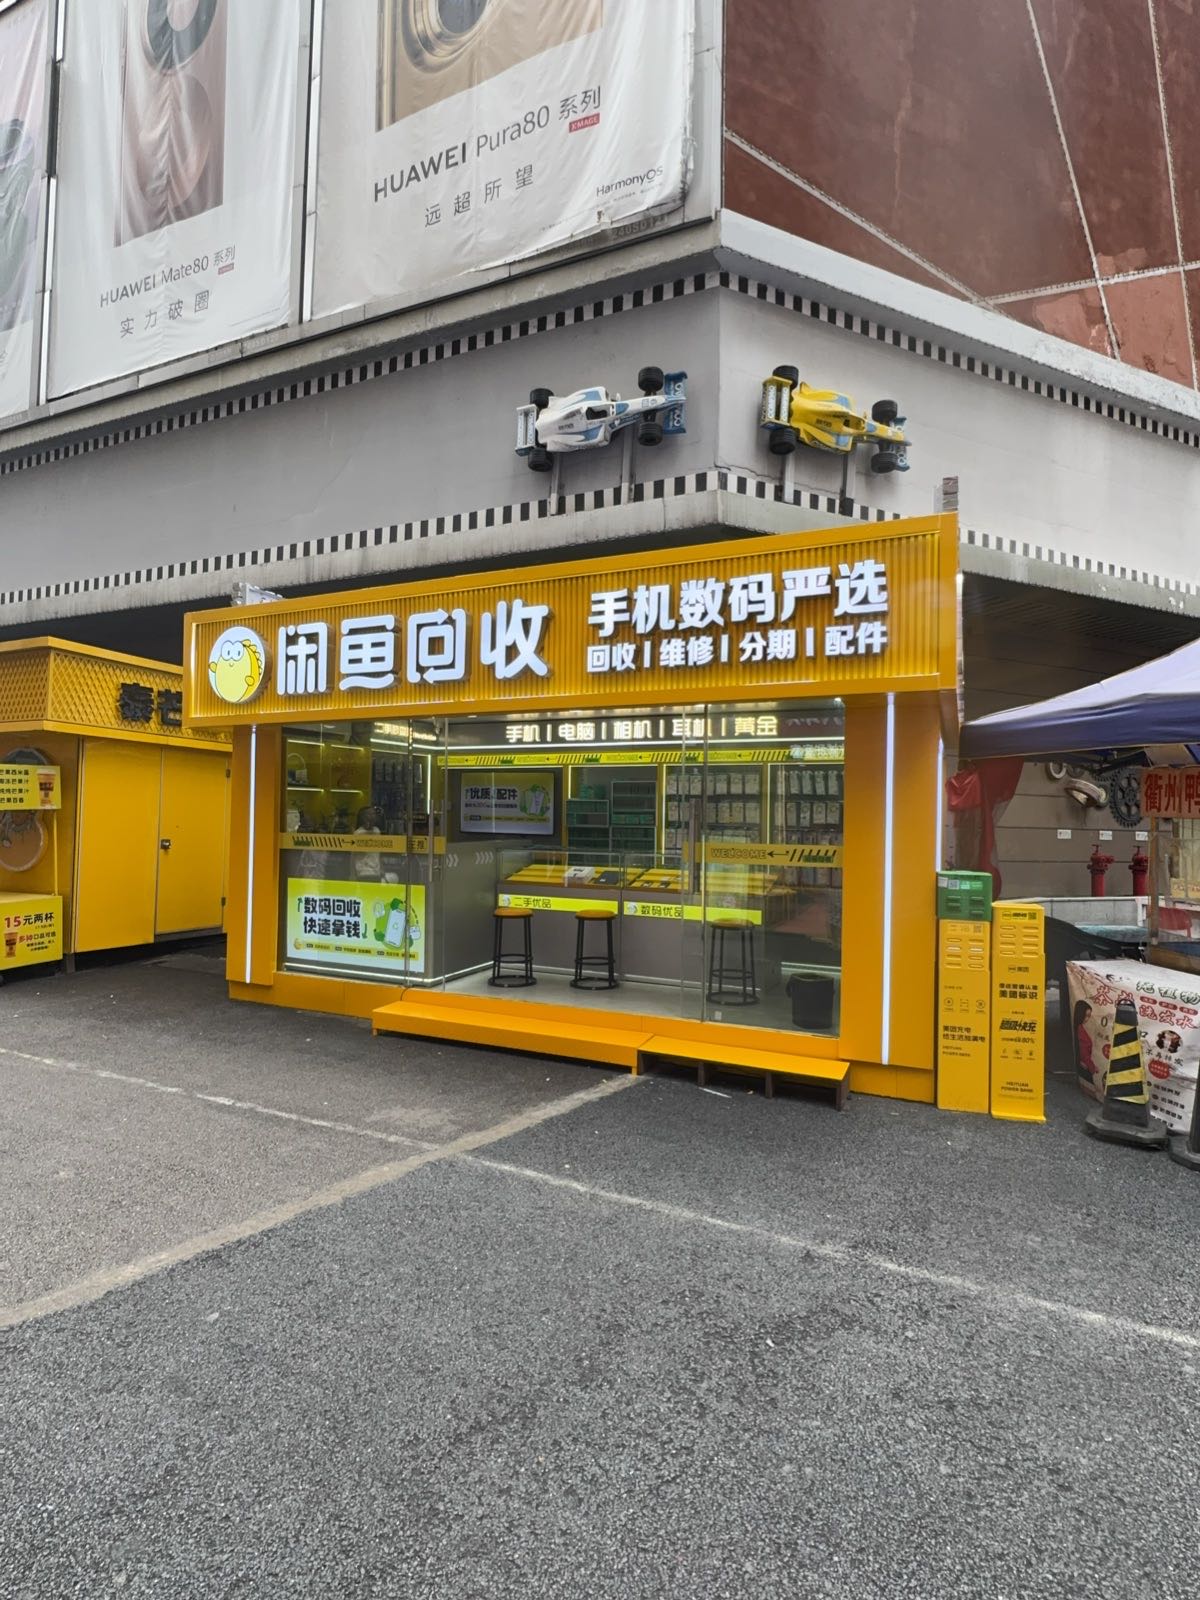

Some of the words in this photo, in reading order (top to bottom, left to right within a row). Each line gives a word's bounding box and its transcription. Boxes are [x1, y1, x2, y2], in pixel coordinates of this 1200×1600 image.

[374, 142, 467, 202] HUAWEI
[476, 105, 550, 158] Pura80
[559, 85, 600, 121] 系列
[424, 164, 533, 227] 远超所望
[596, 166, 663, 197] HarmonyOS
[100, 273, 156, 307] HUAWEI
[161, 256, 209, 285] Mate80
[214, 244, 236, 266] 系列
[120, 290, 209, 338] 实力破圈
[587, 559, 888, 637] 手机数码严选
[277, 598, 549, 696] 闲鱼回收
[587, 643, 636, 672] 回收
[659, 634, 714, 668] 维修
[739, 628, 796, 662] 分期
[824, 622, 888, 656] 配件
[506, 723, 540, 743] 手机
[558, 721, 596, 742] 电脑
[613, 719, 652, 740] 相机
[672, 717, 712, 738] 耳机
[734, 715, 778, 737] 黄金
[711, 847, 768, 860] WELCOME
[303, 897, 361, 918] 数码回收
[514, 897, 551, 909] 二手优品
[640, 905, 683, 918] 数码优品
[5, 912, 54, 928] 15元两杯
[303, 917, 361, 939] 快速拿钱
